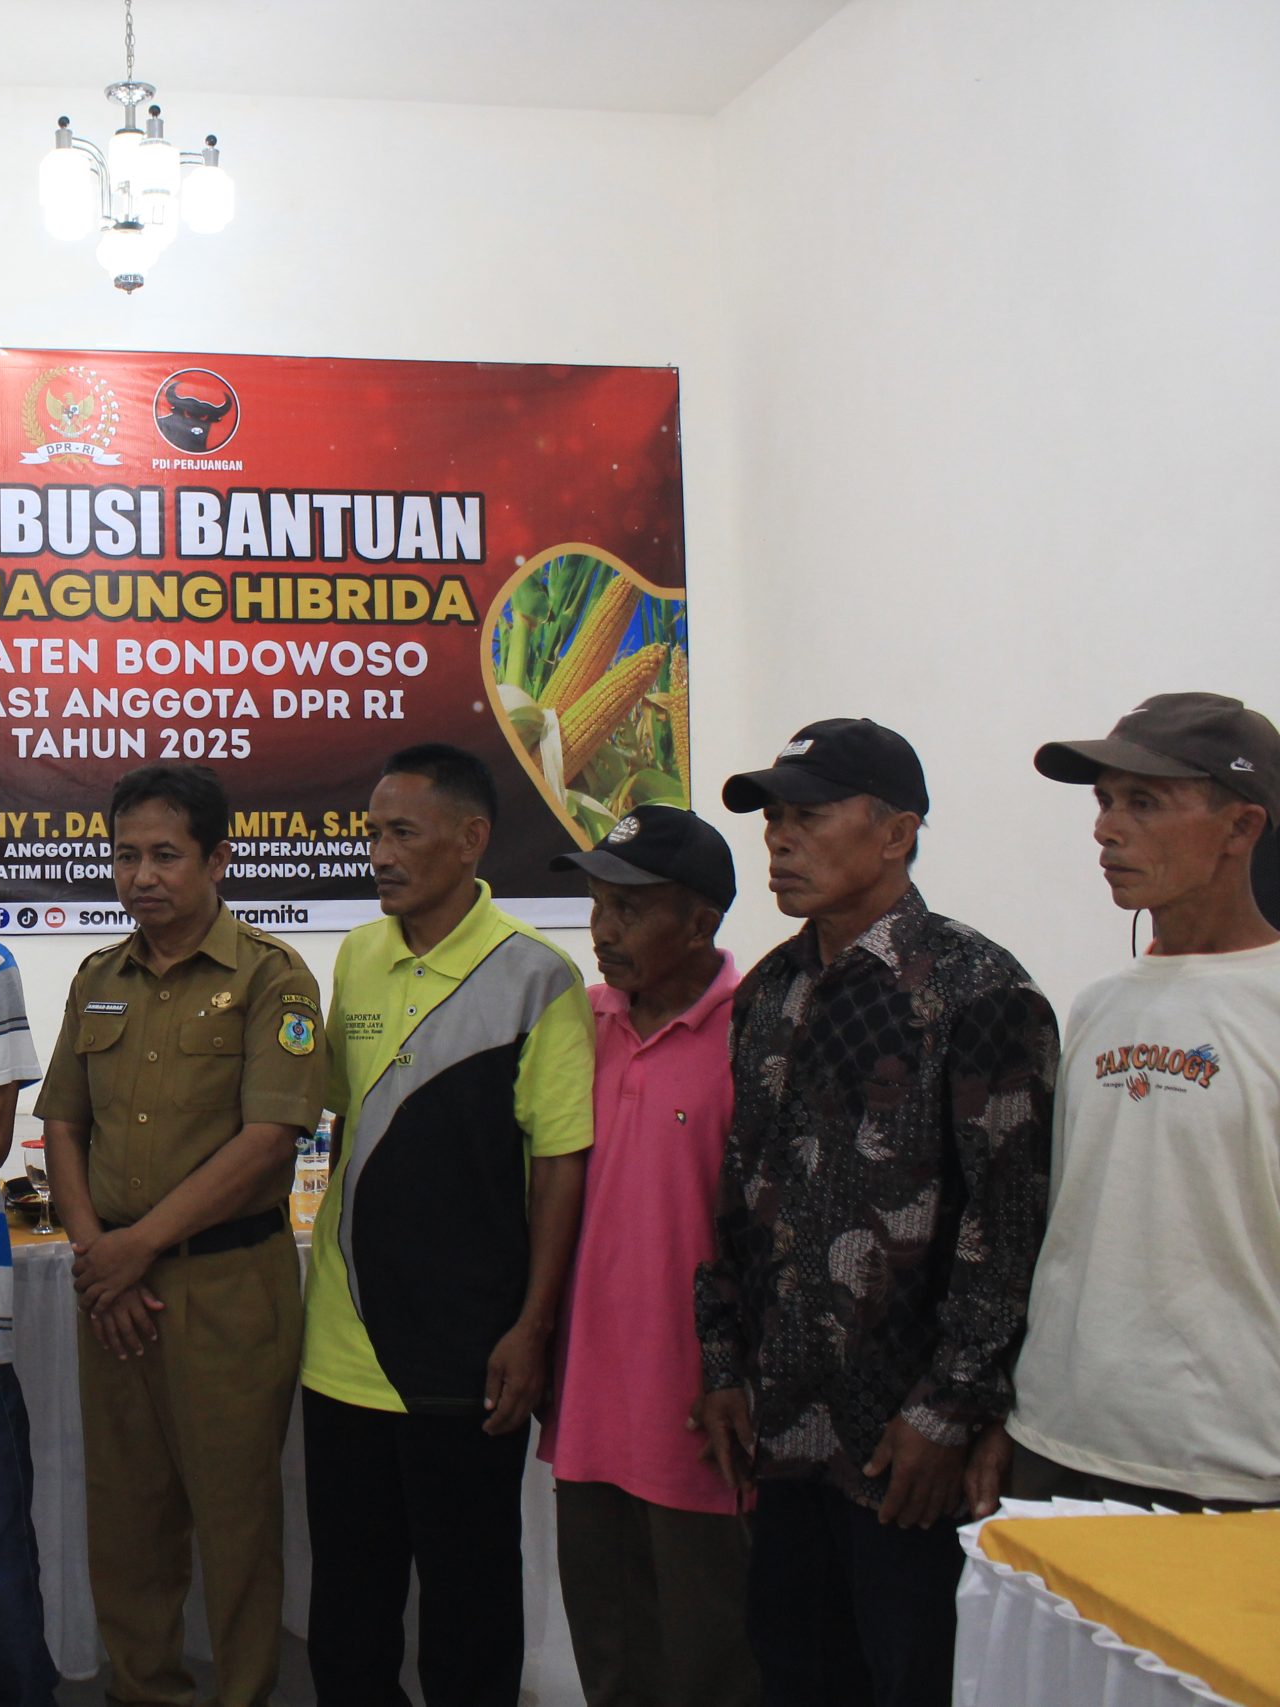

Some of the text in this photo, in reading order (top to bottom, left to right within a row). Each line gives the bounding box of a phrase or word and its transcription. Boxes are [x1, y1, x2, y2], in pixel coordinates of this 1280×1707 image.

[152, 458, 244, 472] PDI PERJUANGAN
[179, 491, 481, 561] BANTUAN
[240, 576, 476, 622] HIBRIDA
[115, 640, 429, 678] BONDOWOSO
[61, 688, 260, 720] ANGGOTA
[273, 689, 351, 720] DPR
[363, 689, 405, 720] RI
[11, 727, 252, 761] TAHUN 2025
[33, 812, 59, 838] T.
[66, 812, 108, 838] DA
[4, 842, 97, 858] ANGGOTA
[45, 864, 61, 879] III
[65, 861, 114, 883] (BON
[225, 863, 315, 879] TUBONDO,
[231, 904, 308, 923] ramita
